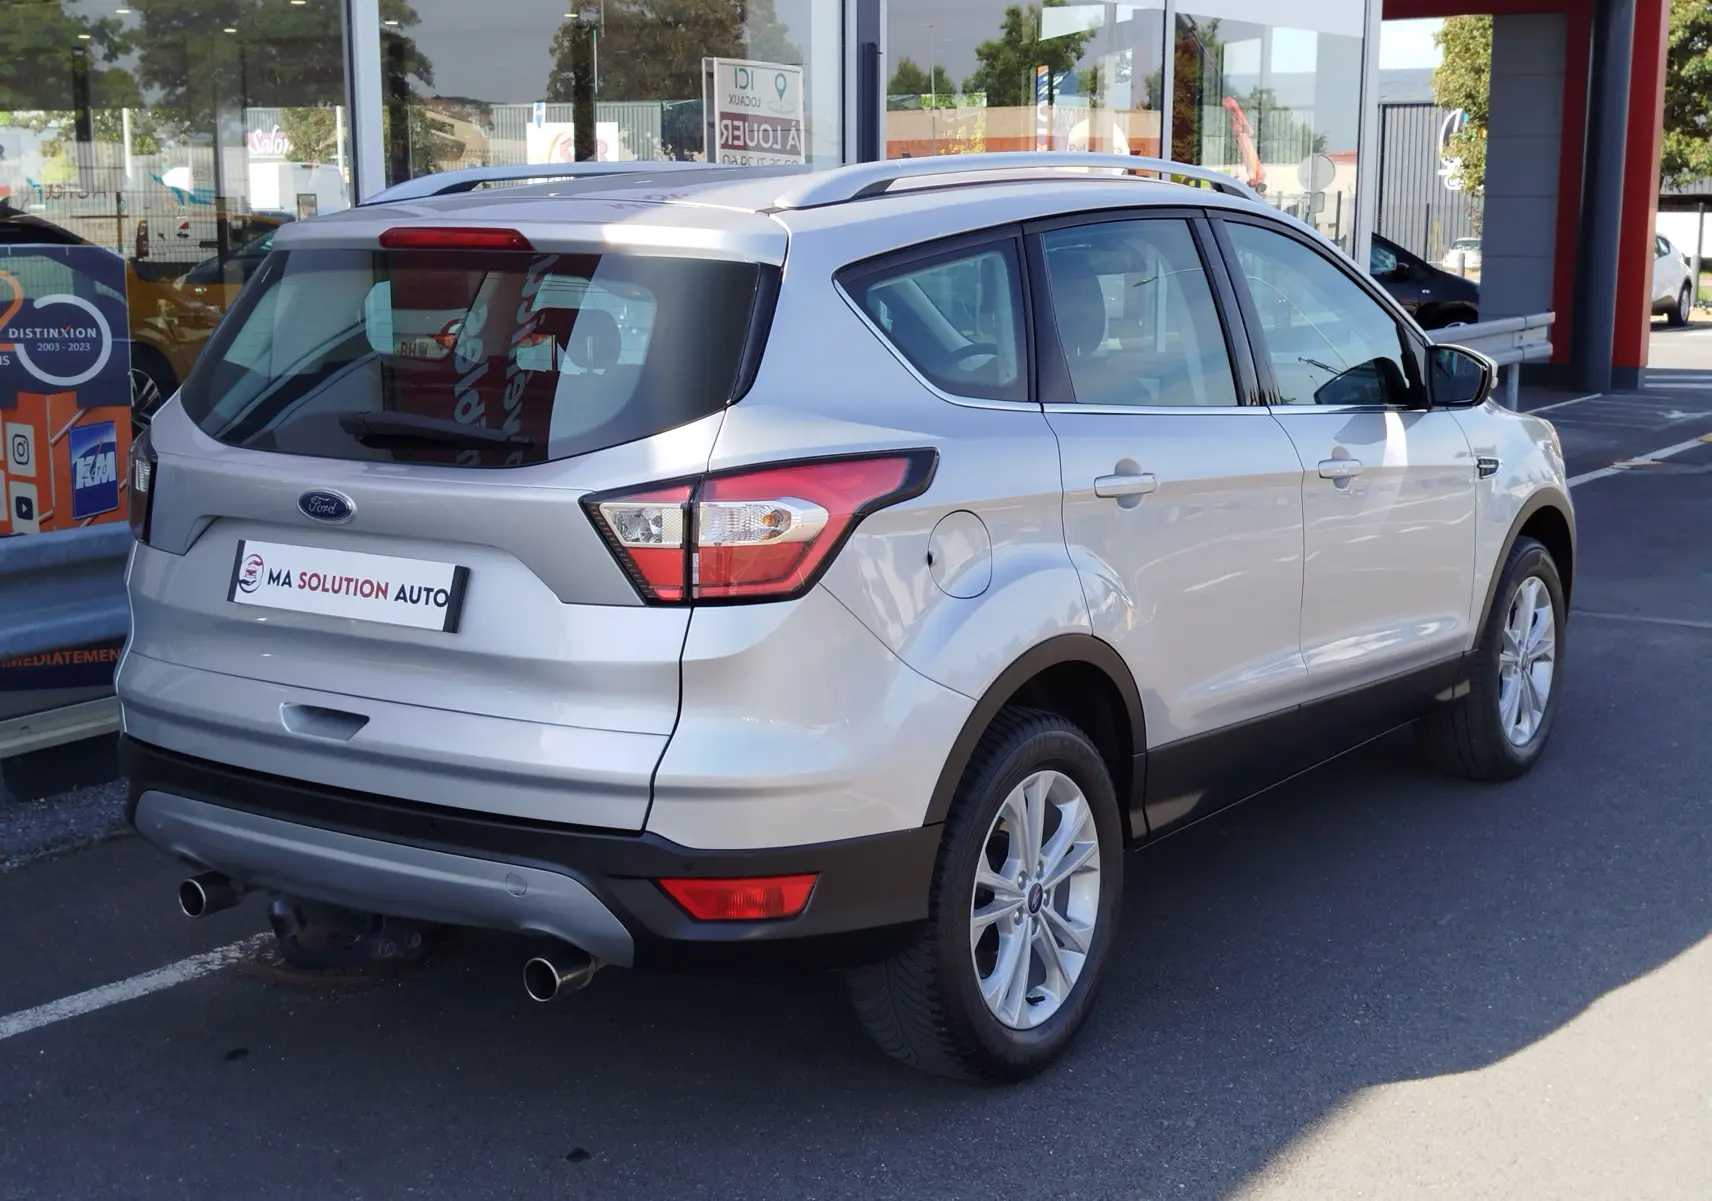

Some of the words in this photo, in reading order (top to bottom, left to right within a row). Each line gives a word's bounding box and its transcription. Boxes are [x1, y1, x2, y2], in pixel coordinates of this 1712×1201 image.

[8, 325, 97, 340] DISTINXION
[37, 343, 60, 352] 2003
[68, 343, 91, 352] 2023
[308, 496, 337, 515] Ford
[267, 567, 293, 588] MA
[297, 571, 390, 601] SOLUTION
[393, 583, 450, 608] AUTO
